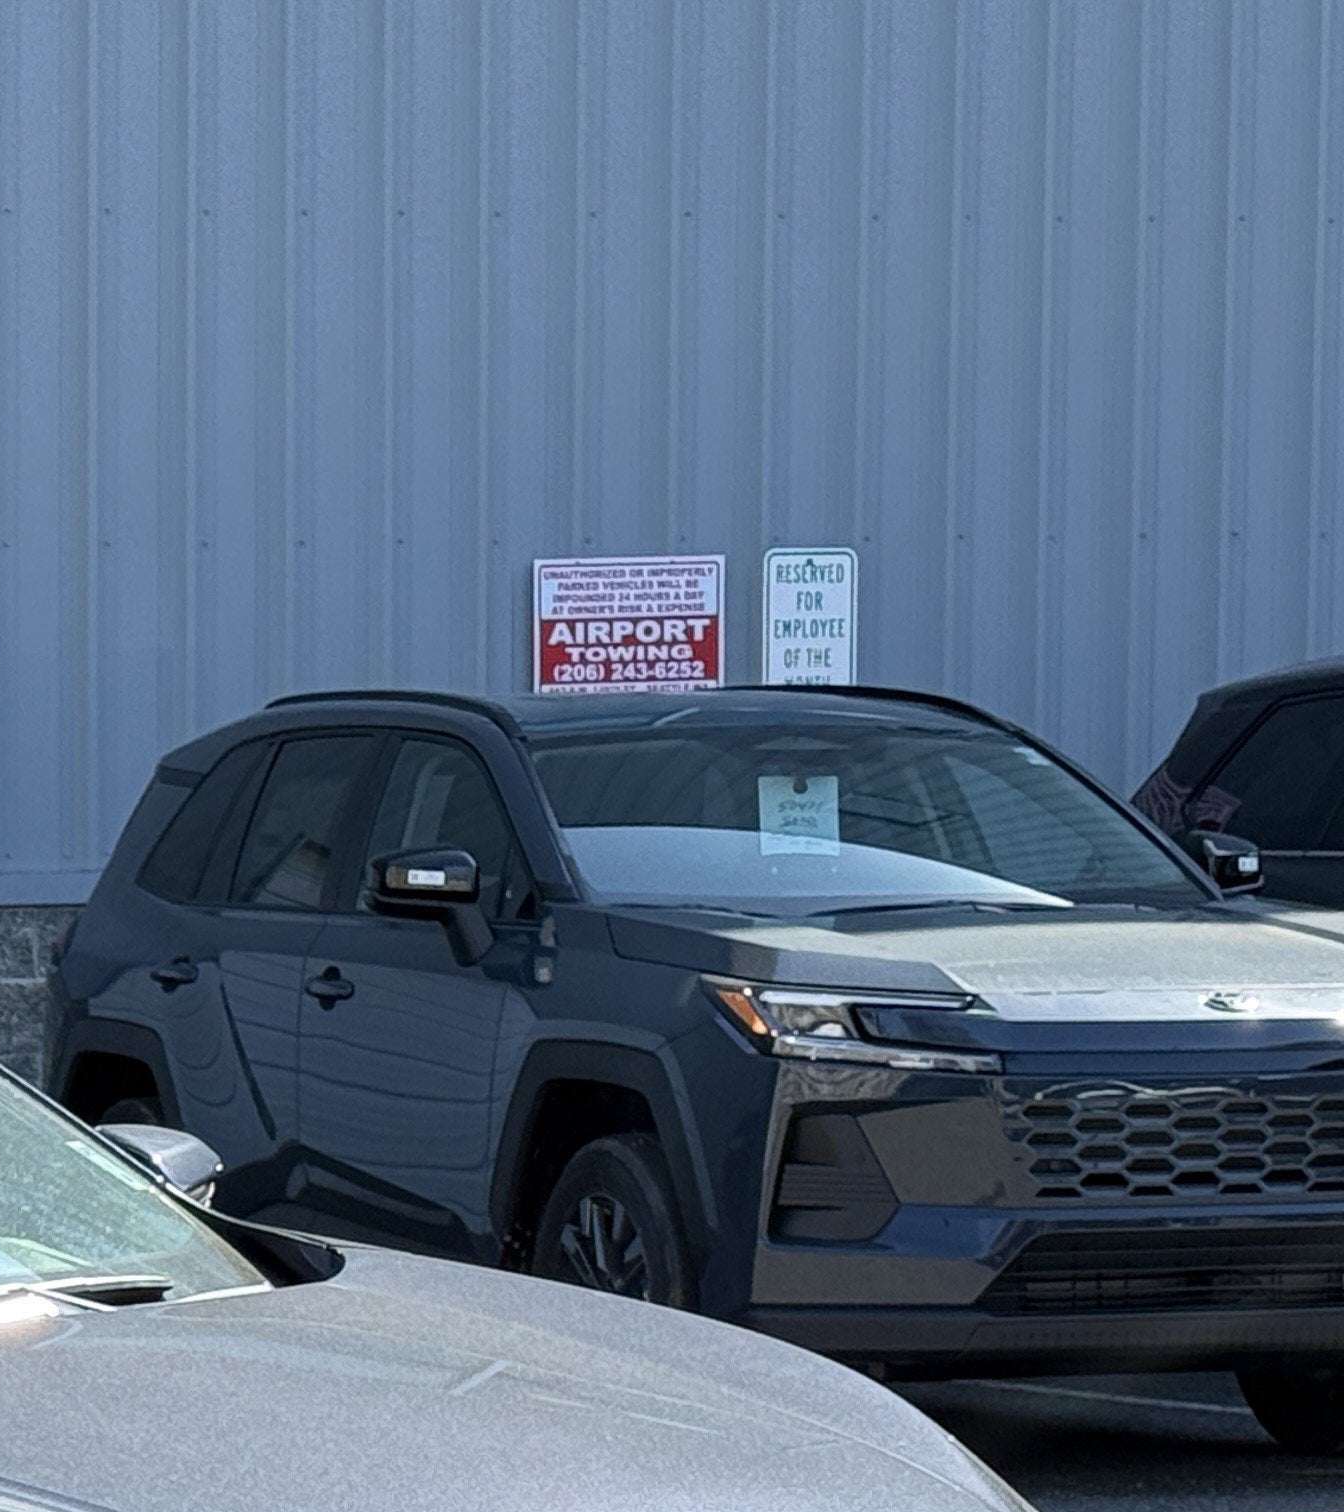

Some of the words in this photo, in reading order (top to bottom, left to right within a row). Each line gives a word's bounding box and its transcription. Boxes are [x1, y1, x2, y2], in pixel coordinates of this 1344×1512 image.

[776, 563, 845, 584] RESERVED
[796, 591, 823, 611] FOR
[548, 618, 710, 646] AIRPORT
[774, 618, 846, 639] EMPLOYEE
[564, 644, 693, 663] TOWING
[783, 648, 801, 668] OF
[806, 647, 832, 668] THE
[553, 663, 605, 682] (206)
[610, 661, 706, 681] 243-6252
